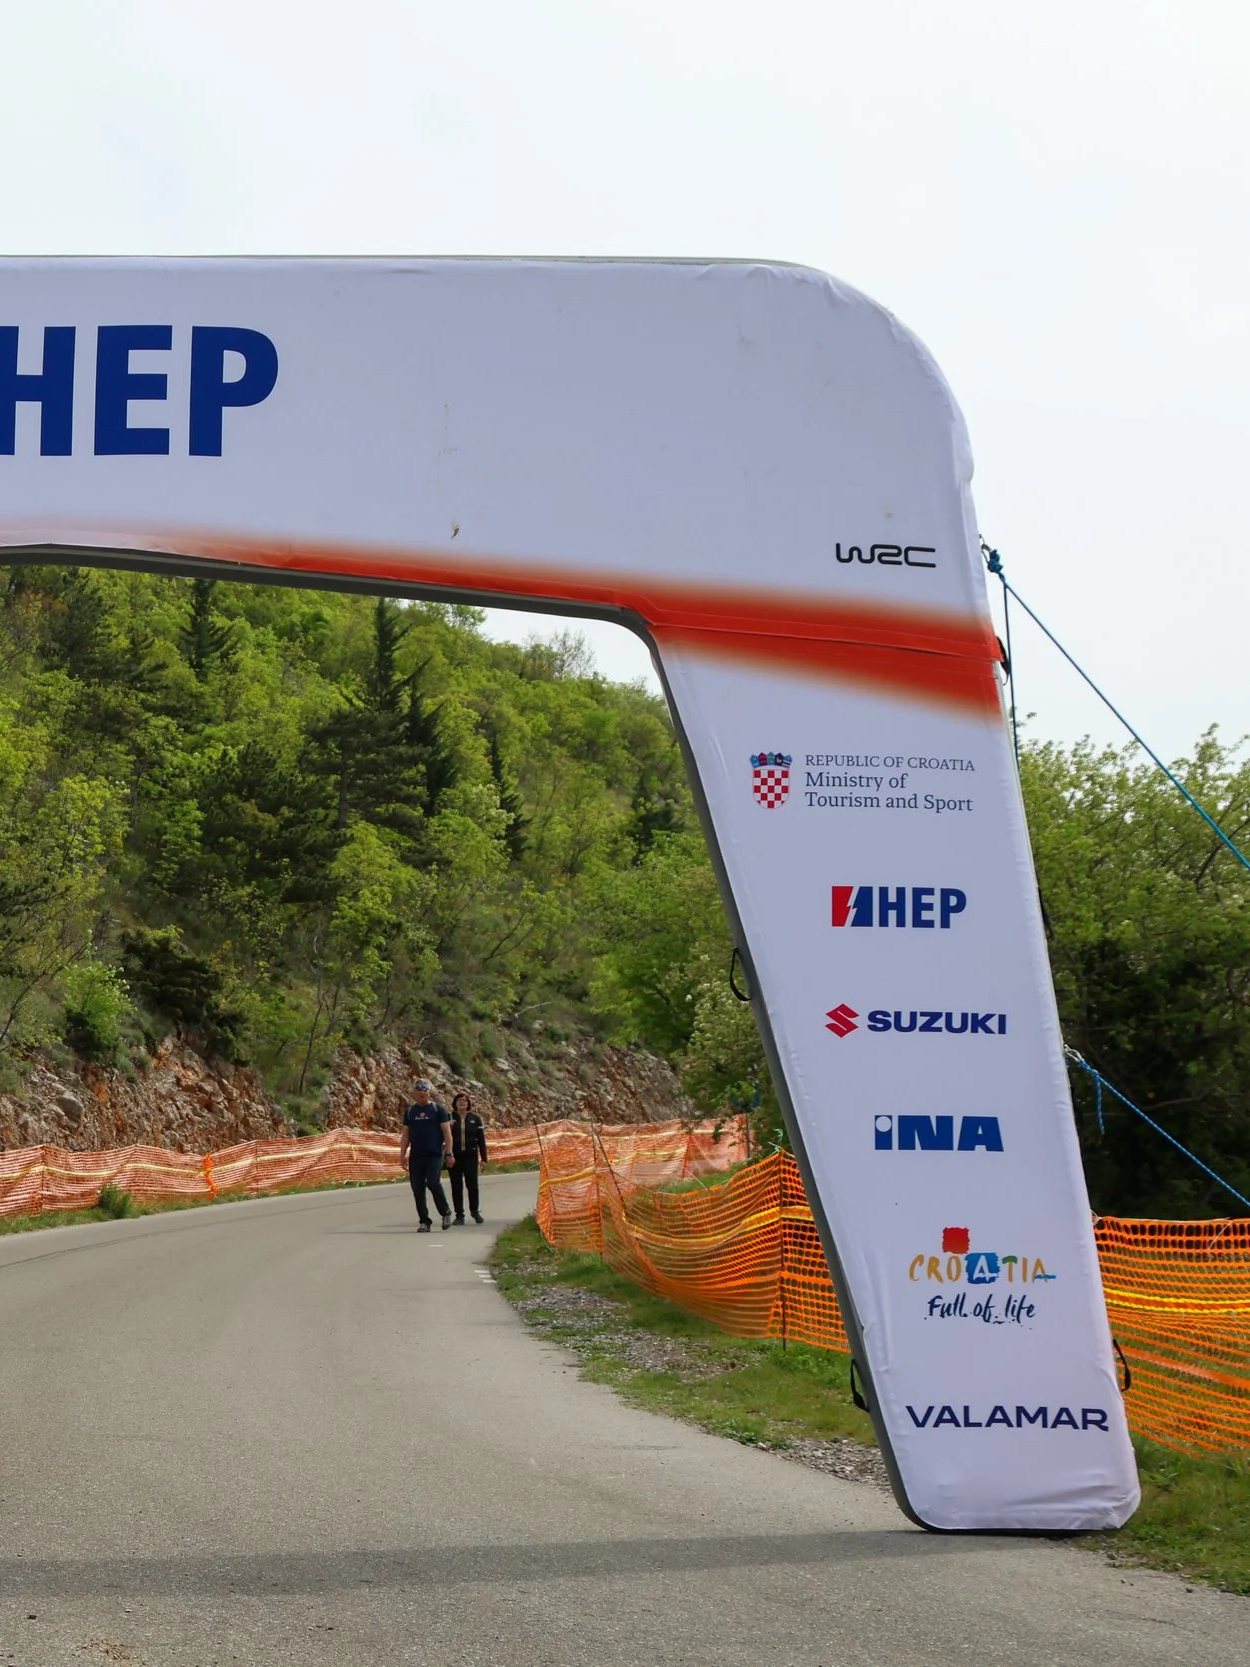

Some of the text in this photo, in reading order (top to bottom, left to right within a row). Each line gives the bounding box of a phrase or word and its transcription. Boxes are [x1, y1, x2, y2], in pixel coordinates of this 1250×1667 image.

[836, 543, 936, 568] WRC
[805, 754, 975, 771] REPUBLIC OF CROATIA
[805, 771, 908, 791] Ministry of
[805, 791, 973, 813] Tourism and Sport
[878, 886, 967, 929] HEP
[867, 1009, 1007, 1035] SUZUKI
[908, 1253, 1057, 1284] CROATIA
[927, 1293, 1035, 1323] Full of life
[905, 1405, 1109, 1432] VALAMAR
